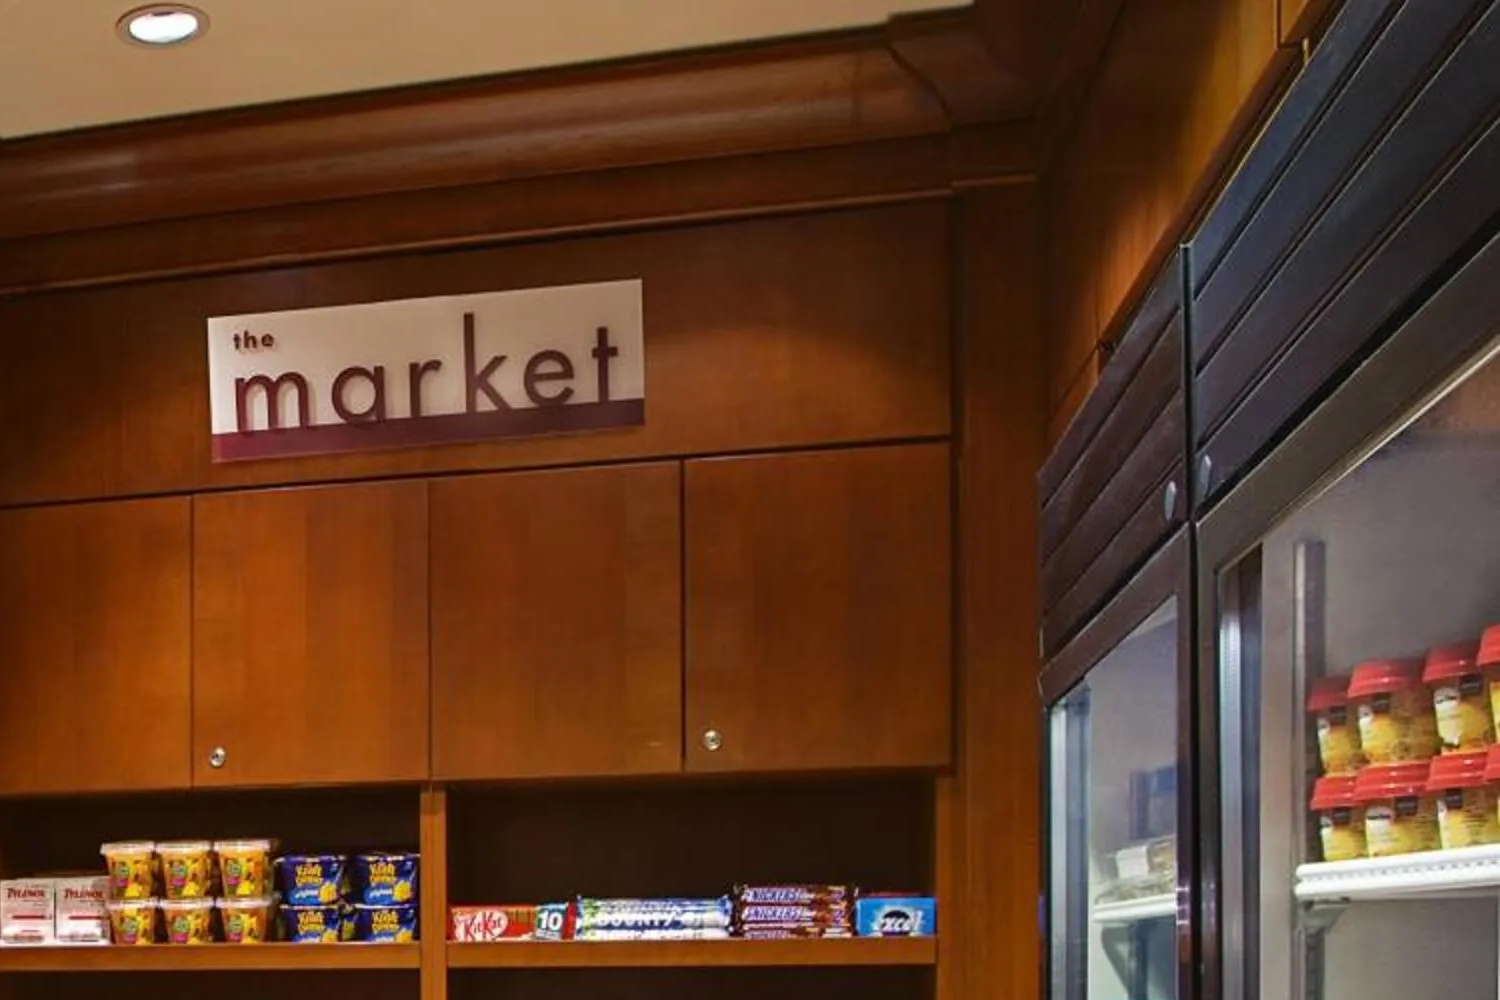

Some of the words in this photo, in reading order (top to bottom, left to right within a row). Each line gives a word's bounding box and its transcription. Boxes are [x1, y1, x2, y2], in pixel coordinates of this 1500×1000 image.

[233, 331, 275, 351] the
[234, 312, 619, 432] market
[537, 910, 563, 931] 10
